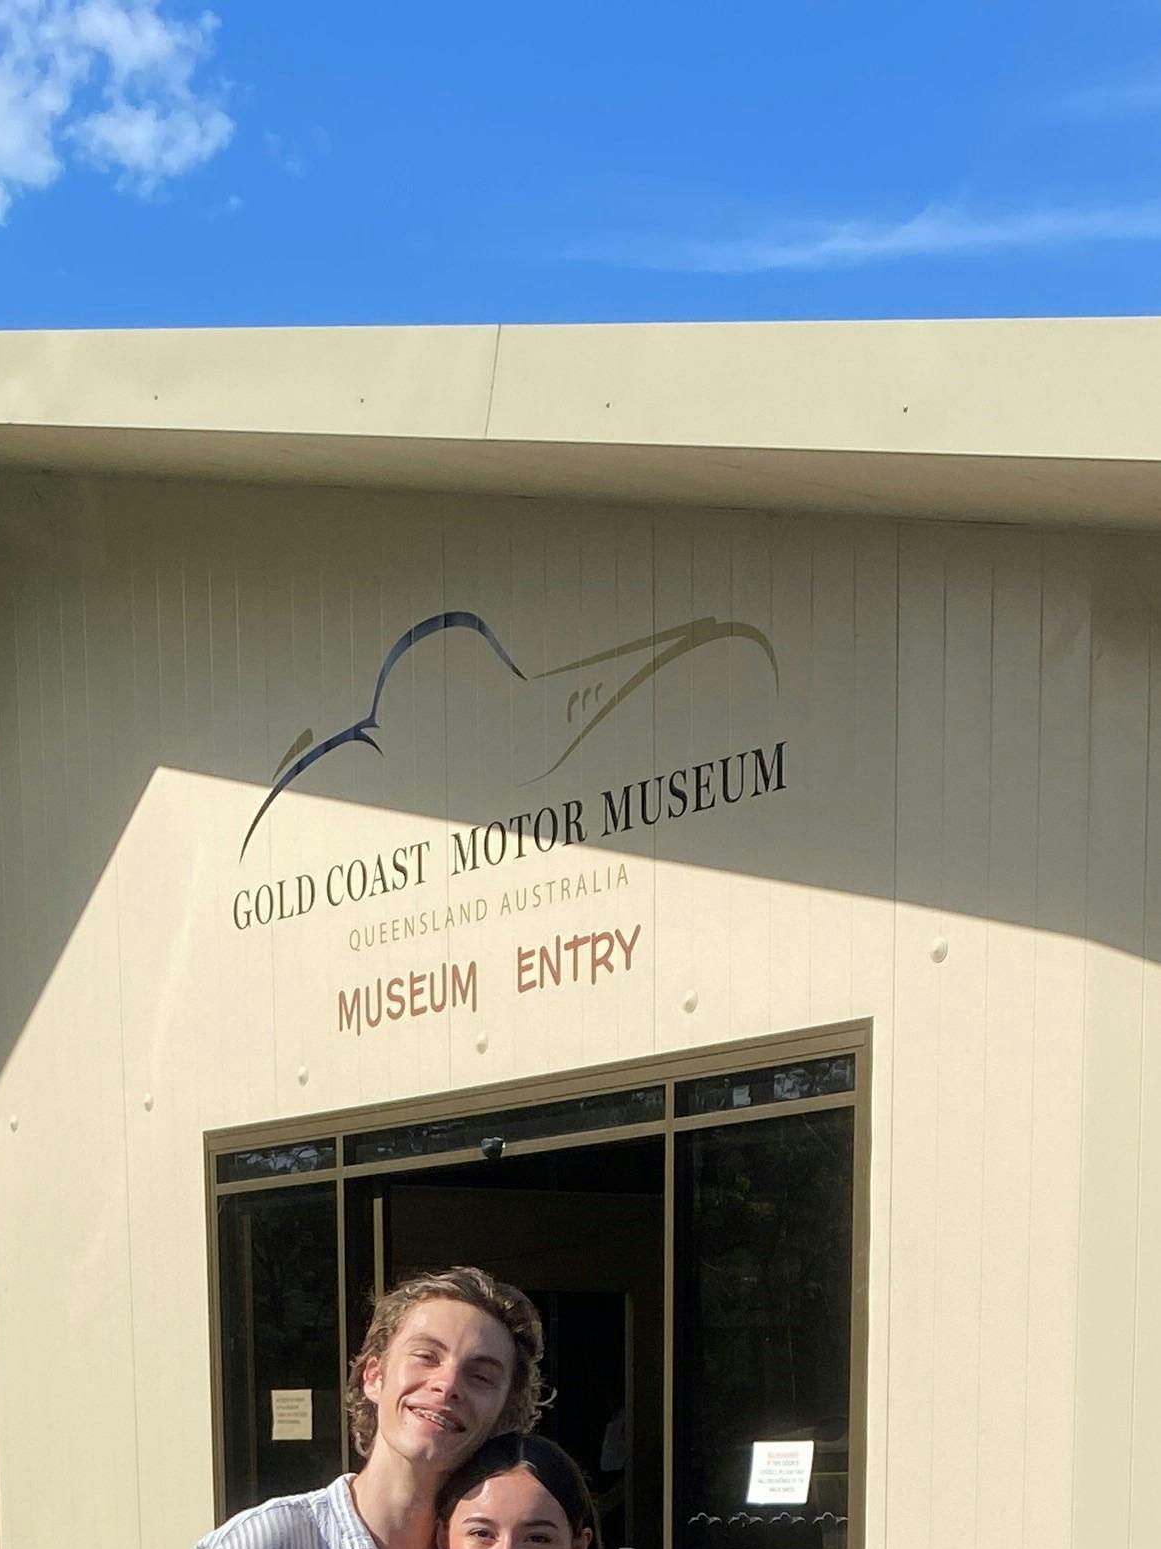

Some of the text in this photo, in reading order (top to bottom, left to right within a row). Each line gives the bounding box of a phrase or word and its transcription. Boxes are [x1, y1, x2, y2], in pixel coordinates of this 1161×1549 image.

[233, 741, 787, 930] GOLD COAST MOTOR MUSEUM
[349, 863, 629, 952] QUEENSLAND AUSTRALIA
[338, 924, 641, 1035] MUSEUM ENTRY
